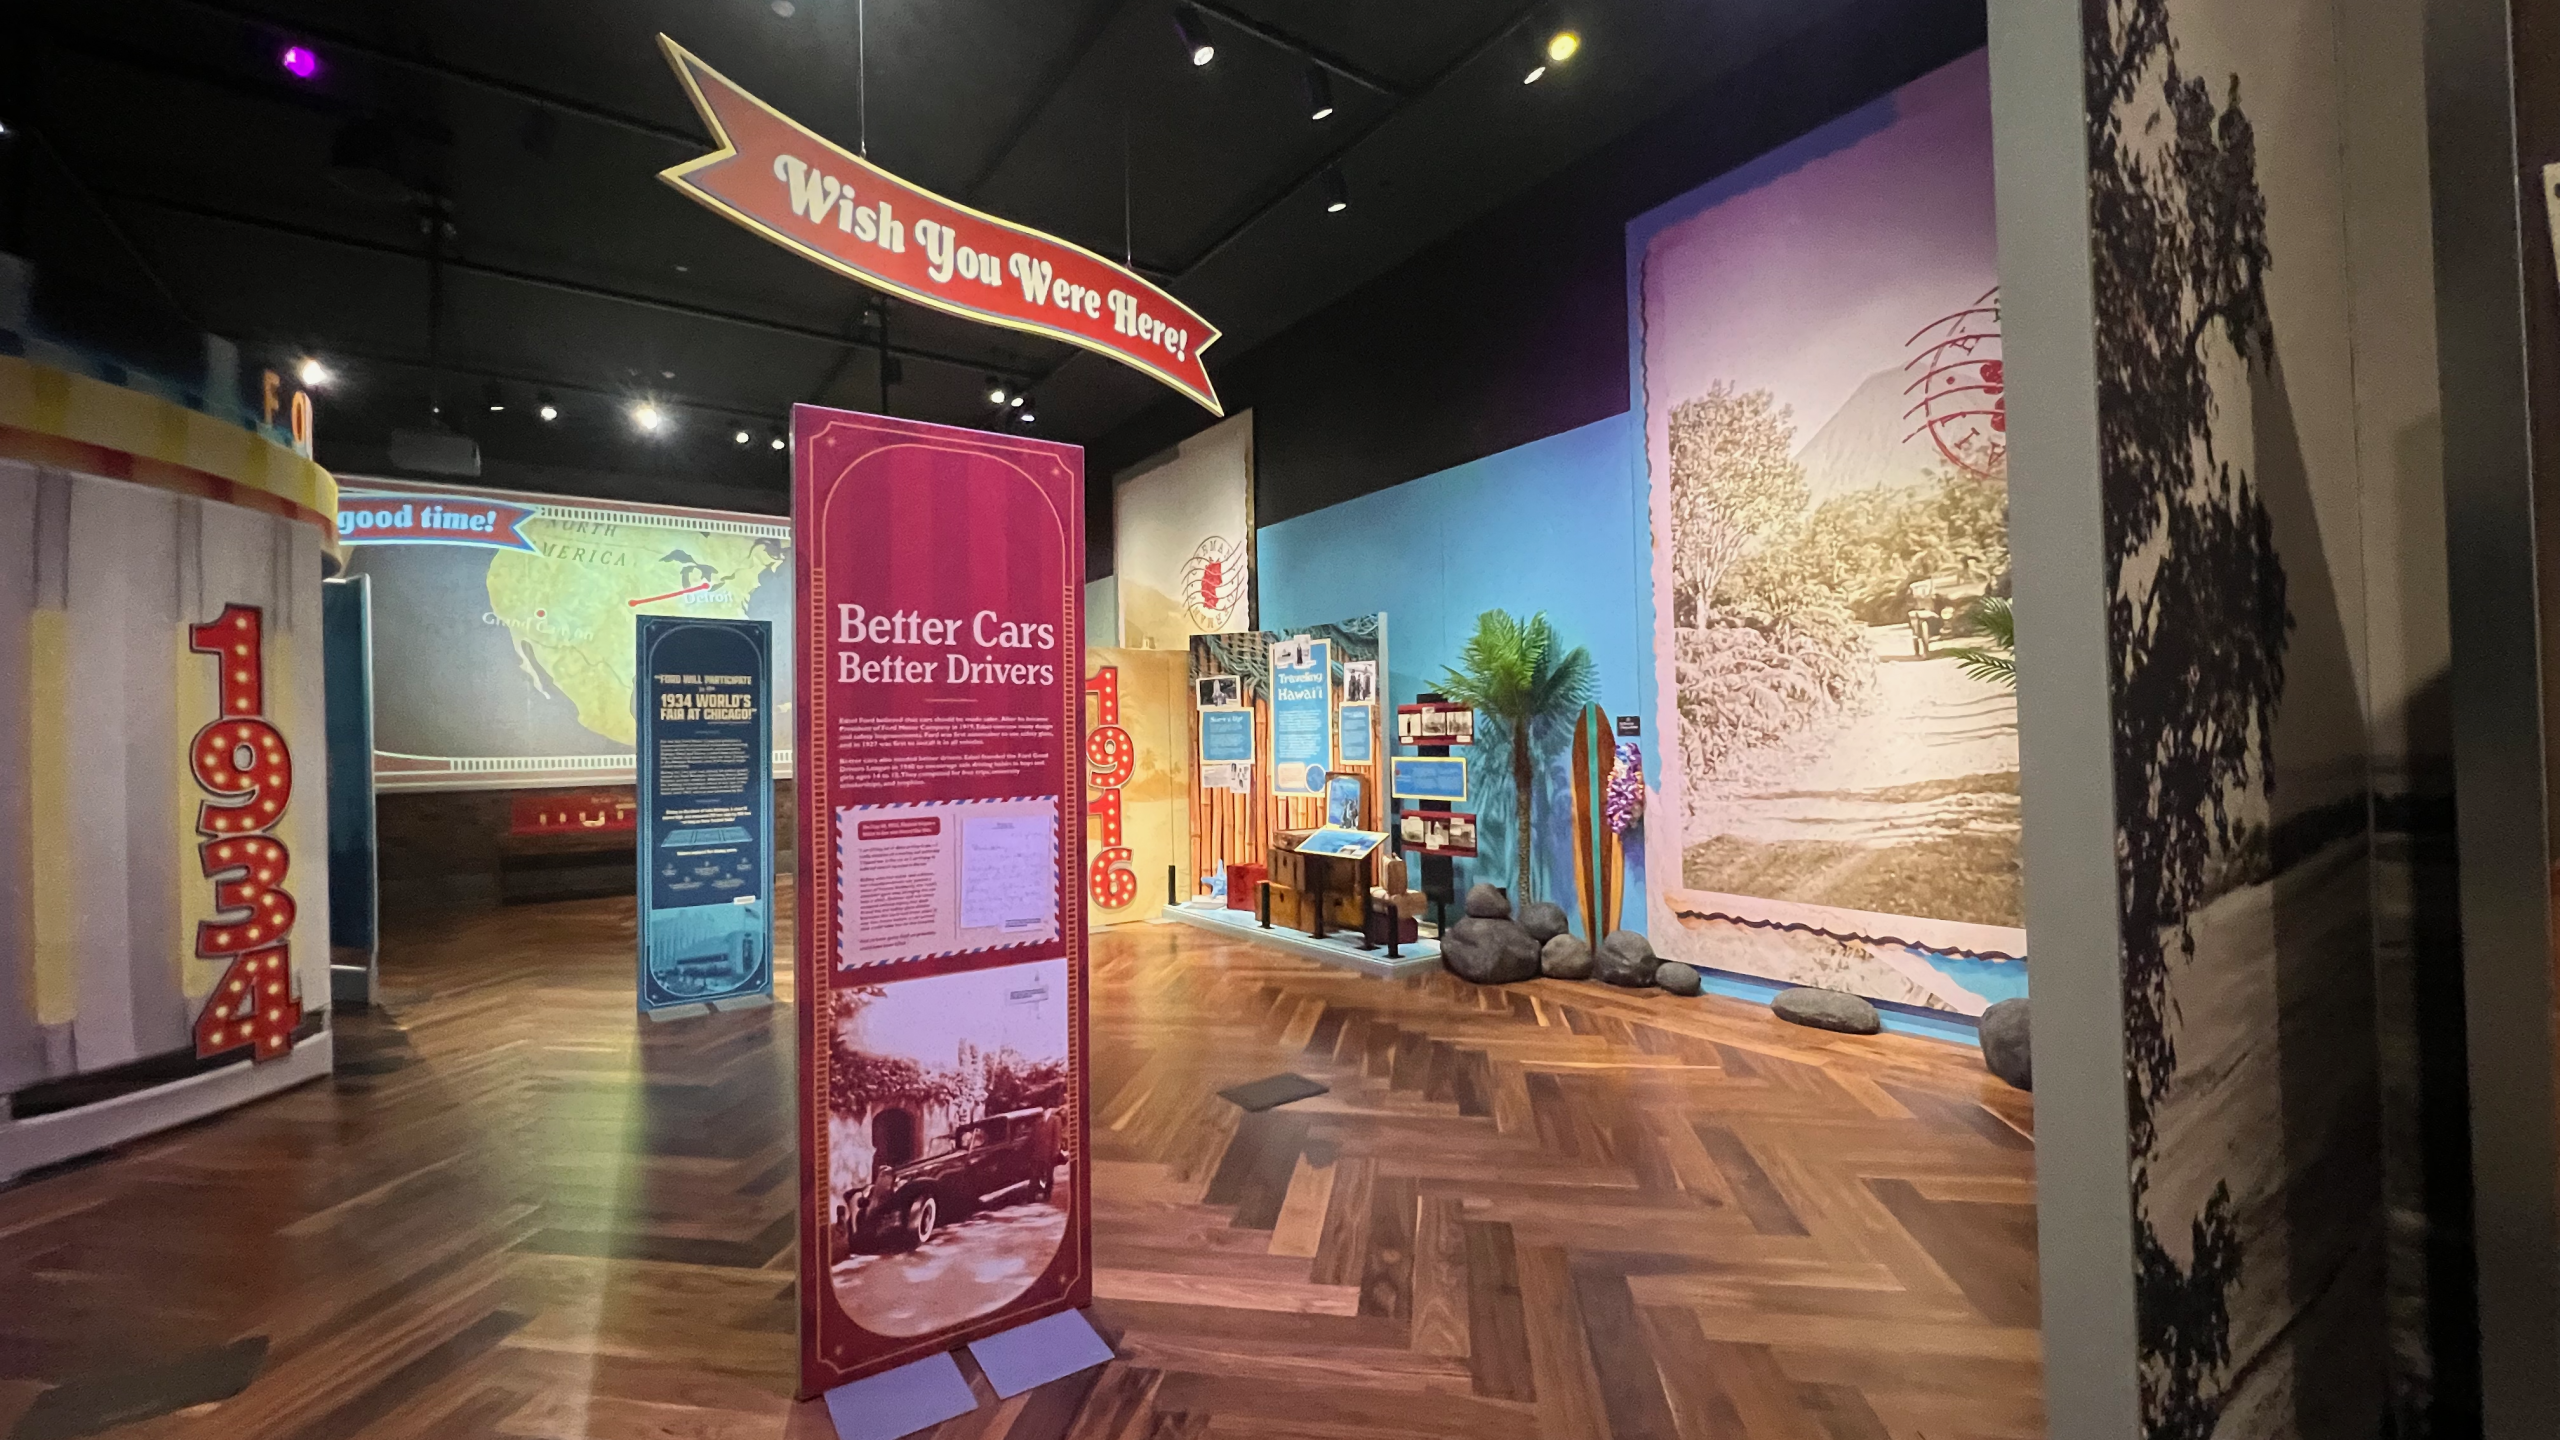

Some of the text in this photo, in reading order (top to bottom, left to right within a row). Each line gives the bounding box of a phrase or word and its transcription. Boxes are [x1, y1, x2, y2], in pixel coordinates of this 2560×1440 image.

[773, 154, 1188, 362] Wish You Were Here!
[338, 504, 497, 534] good time!
[684, 590, 733, 604] Detroit
[837, 603, 1055, 649] Better Cars
[682, 675, 703, 684] WILL
[837, 651, 1054, 686] Better Drivers
[660, 708, 685, 720] FAIR
[687, 708, 701, 720] AT
[661, 694, 752, 708] 1934 WORLD'S
[1085, 665, 1137, 910] 1916
[189, 603, 303, 1063] 1934
